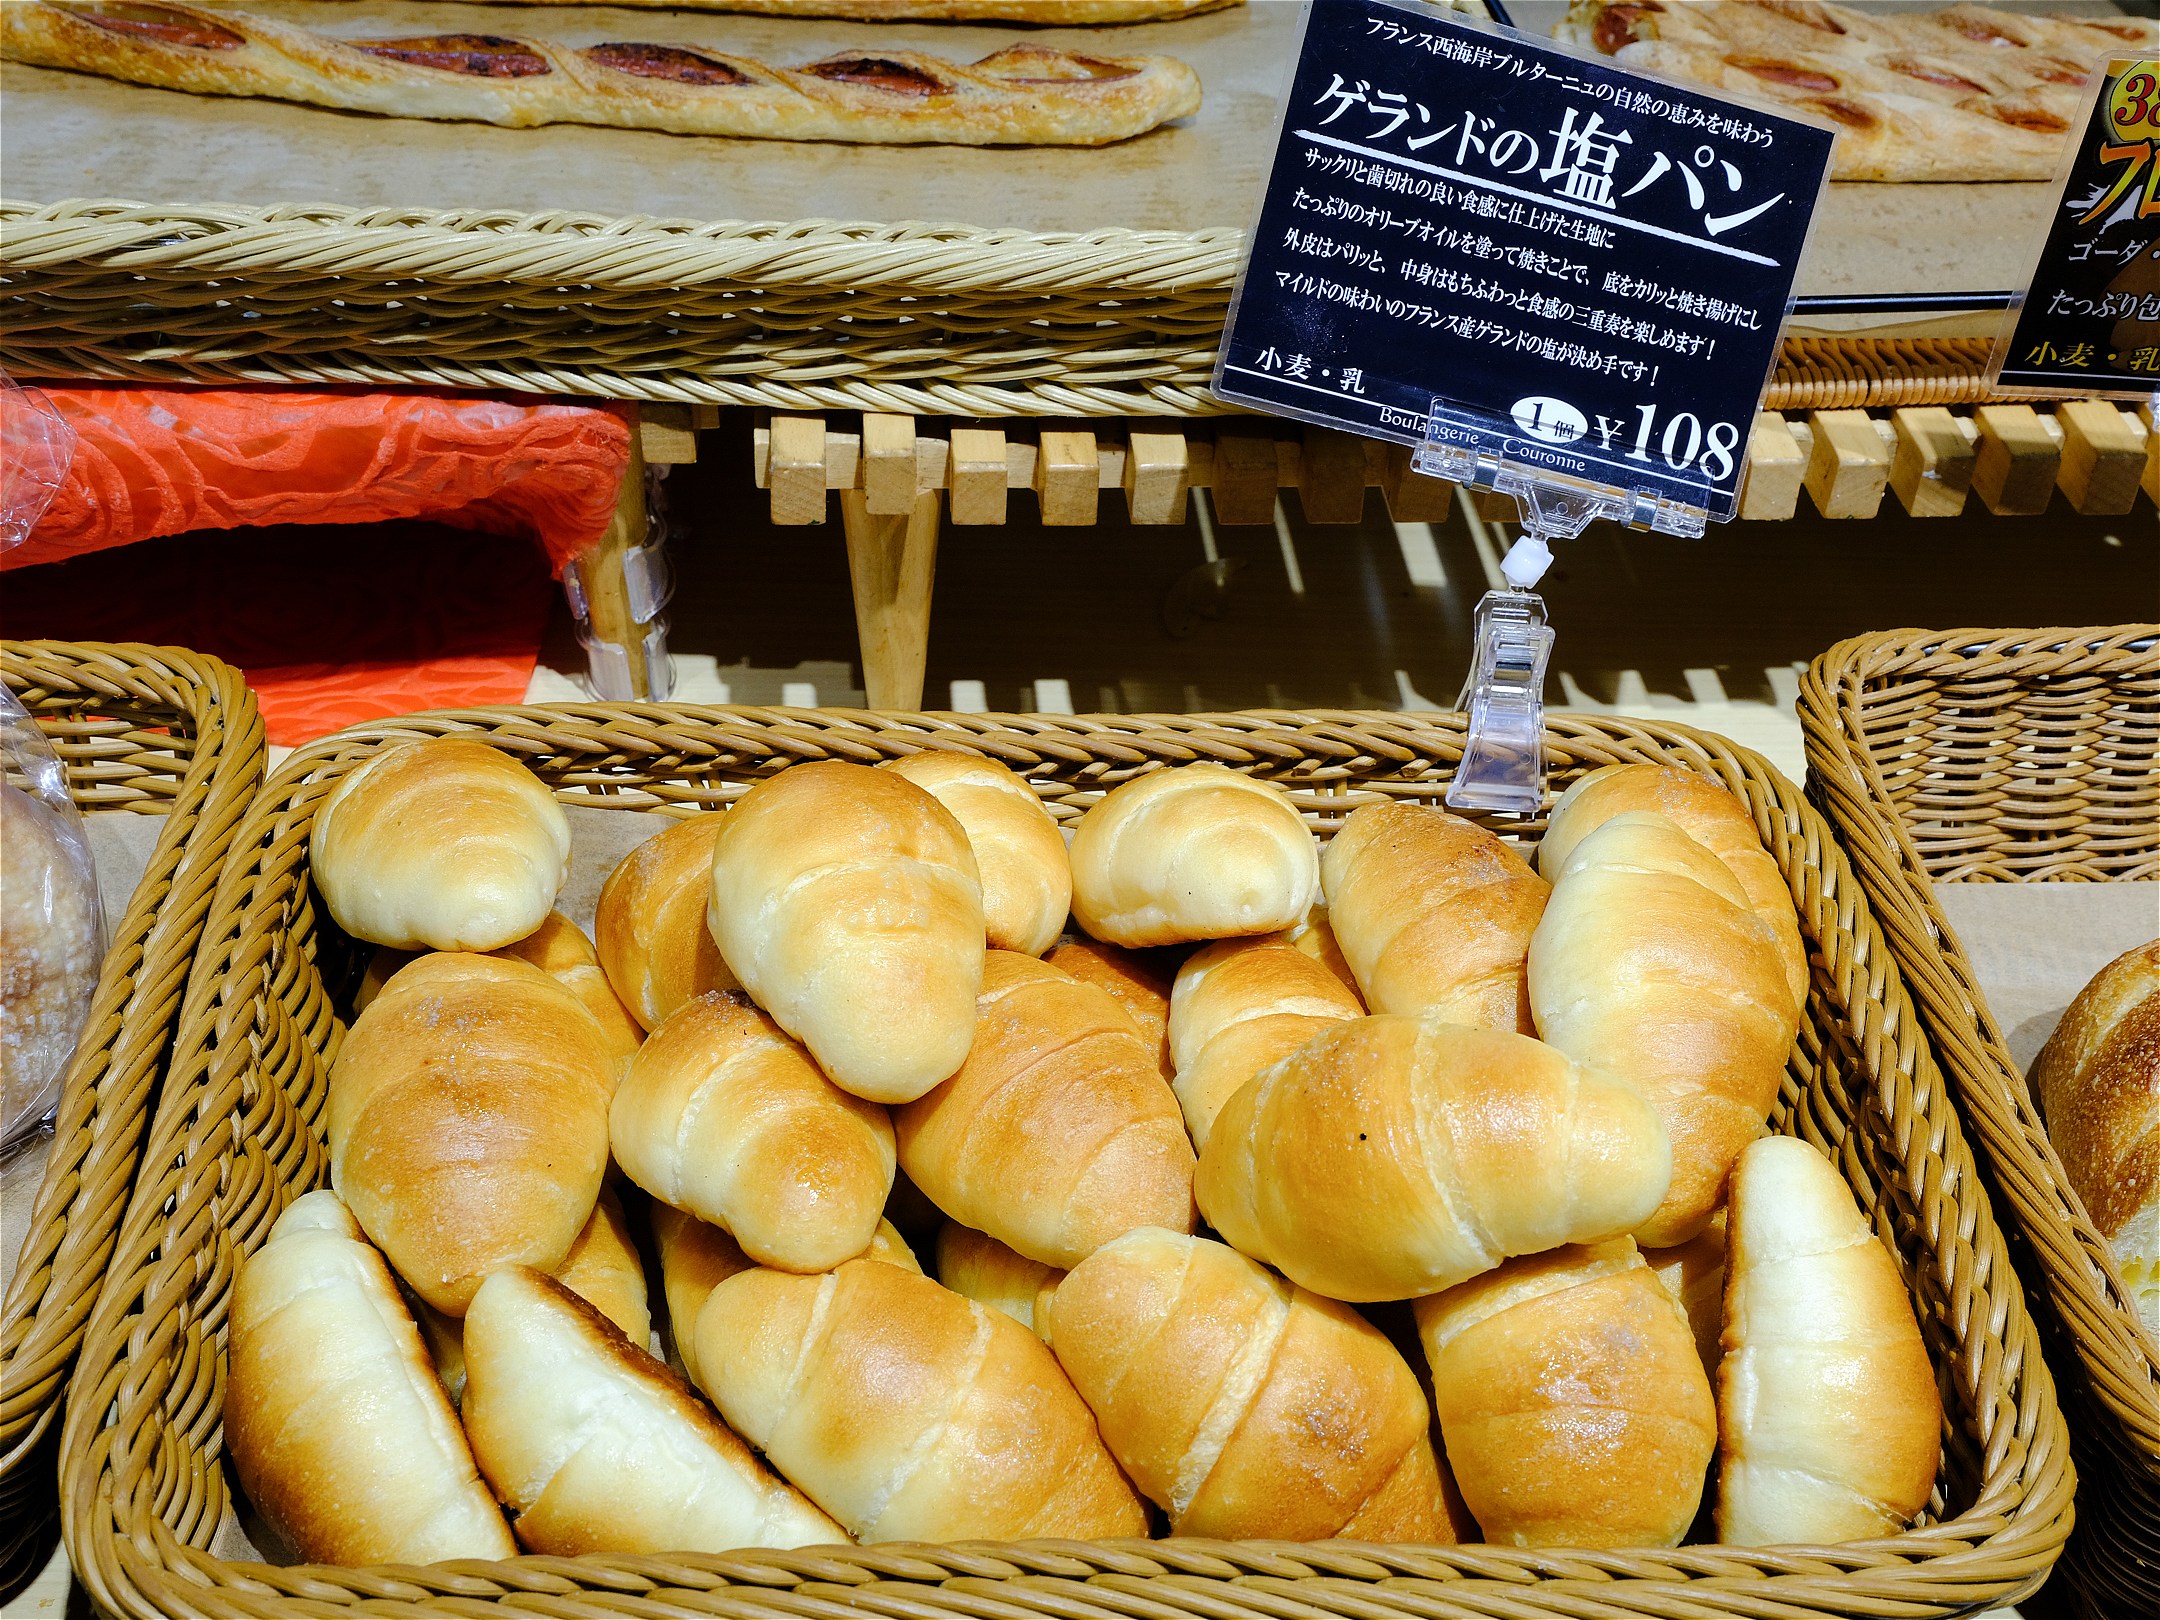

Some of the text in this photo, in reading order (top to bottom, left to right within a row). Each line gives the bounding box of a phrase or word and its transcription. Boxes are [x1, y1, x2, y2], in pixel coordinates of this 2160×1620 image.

[1366, 17, 1773, 148] フランス西海岸ブルターニュの自然の恵みを味わう
[1313, 74, 1785, 236] ゲランドの塩パン
[1305, 147, 1616, 249] サックリと歯切れの良い食感に仕上げた生地に
[1255, 346, 1365, 394] 小麦・乳
[1380, 406, 1586, 472] Boulangerie Couronne
[1528, 402, 1575, 440] 1個
